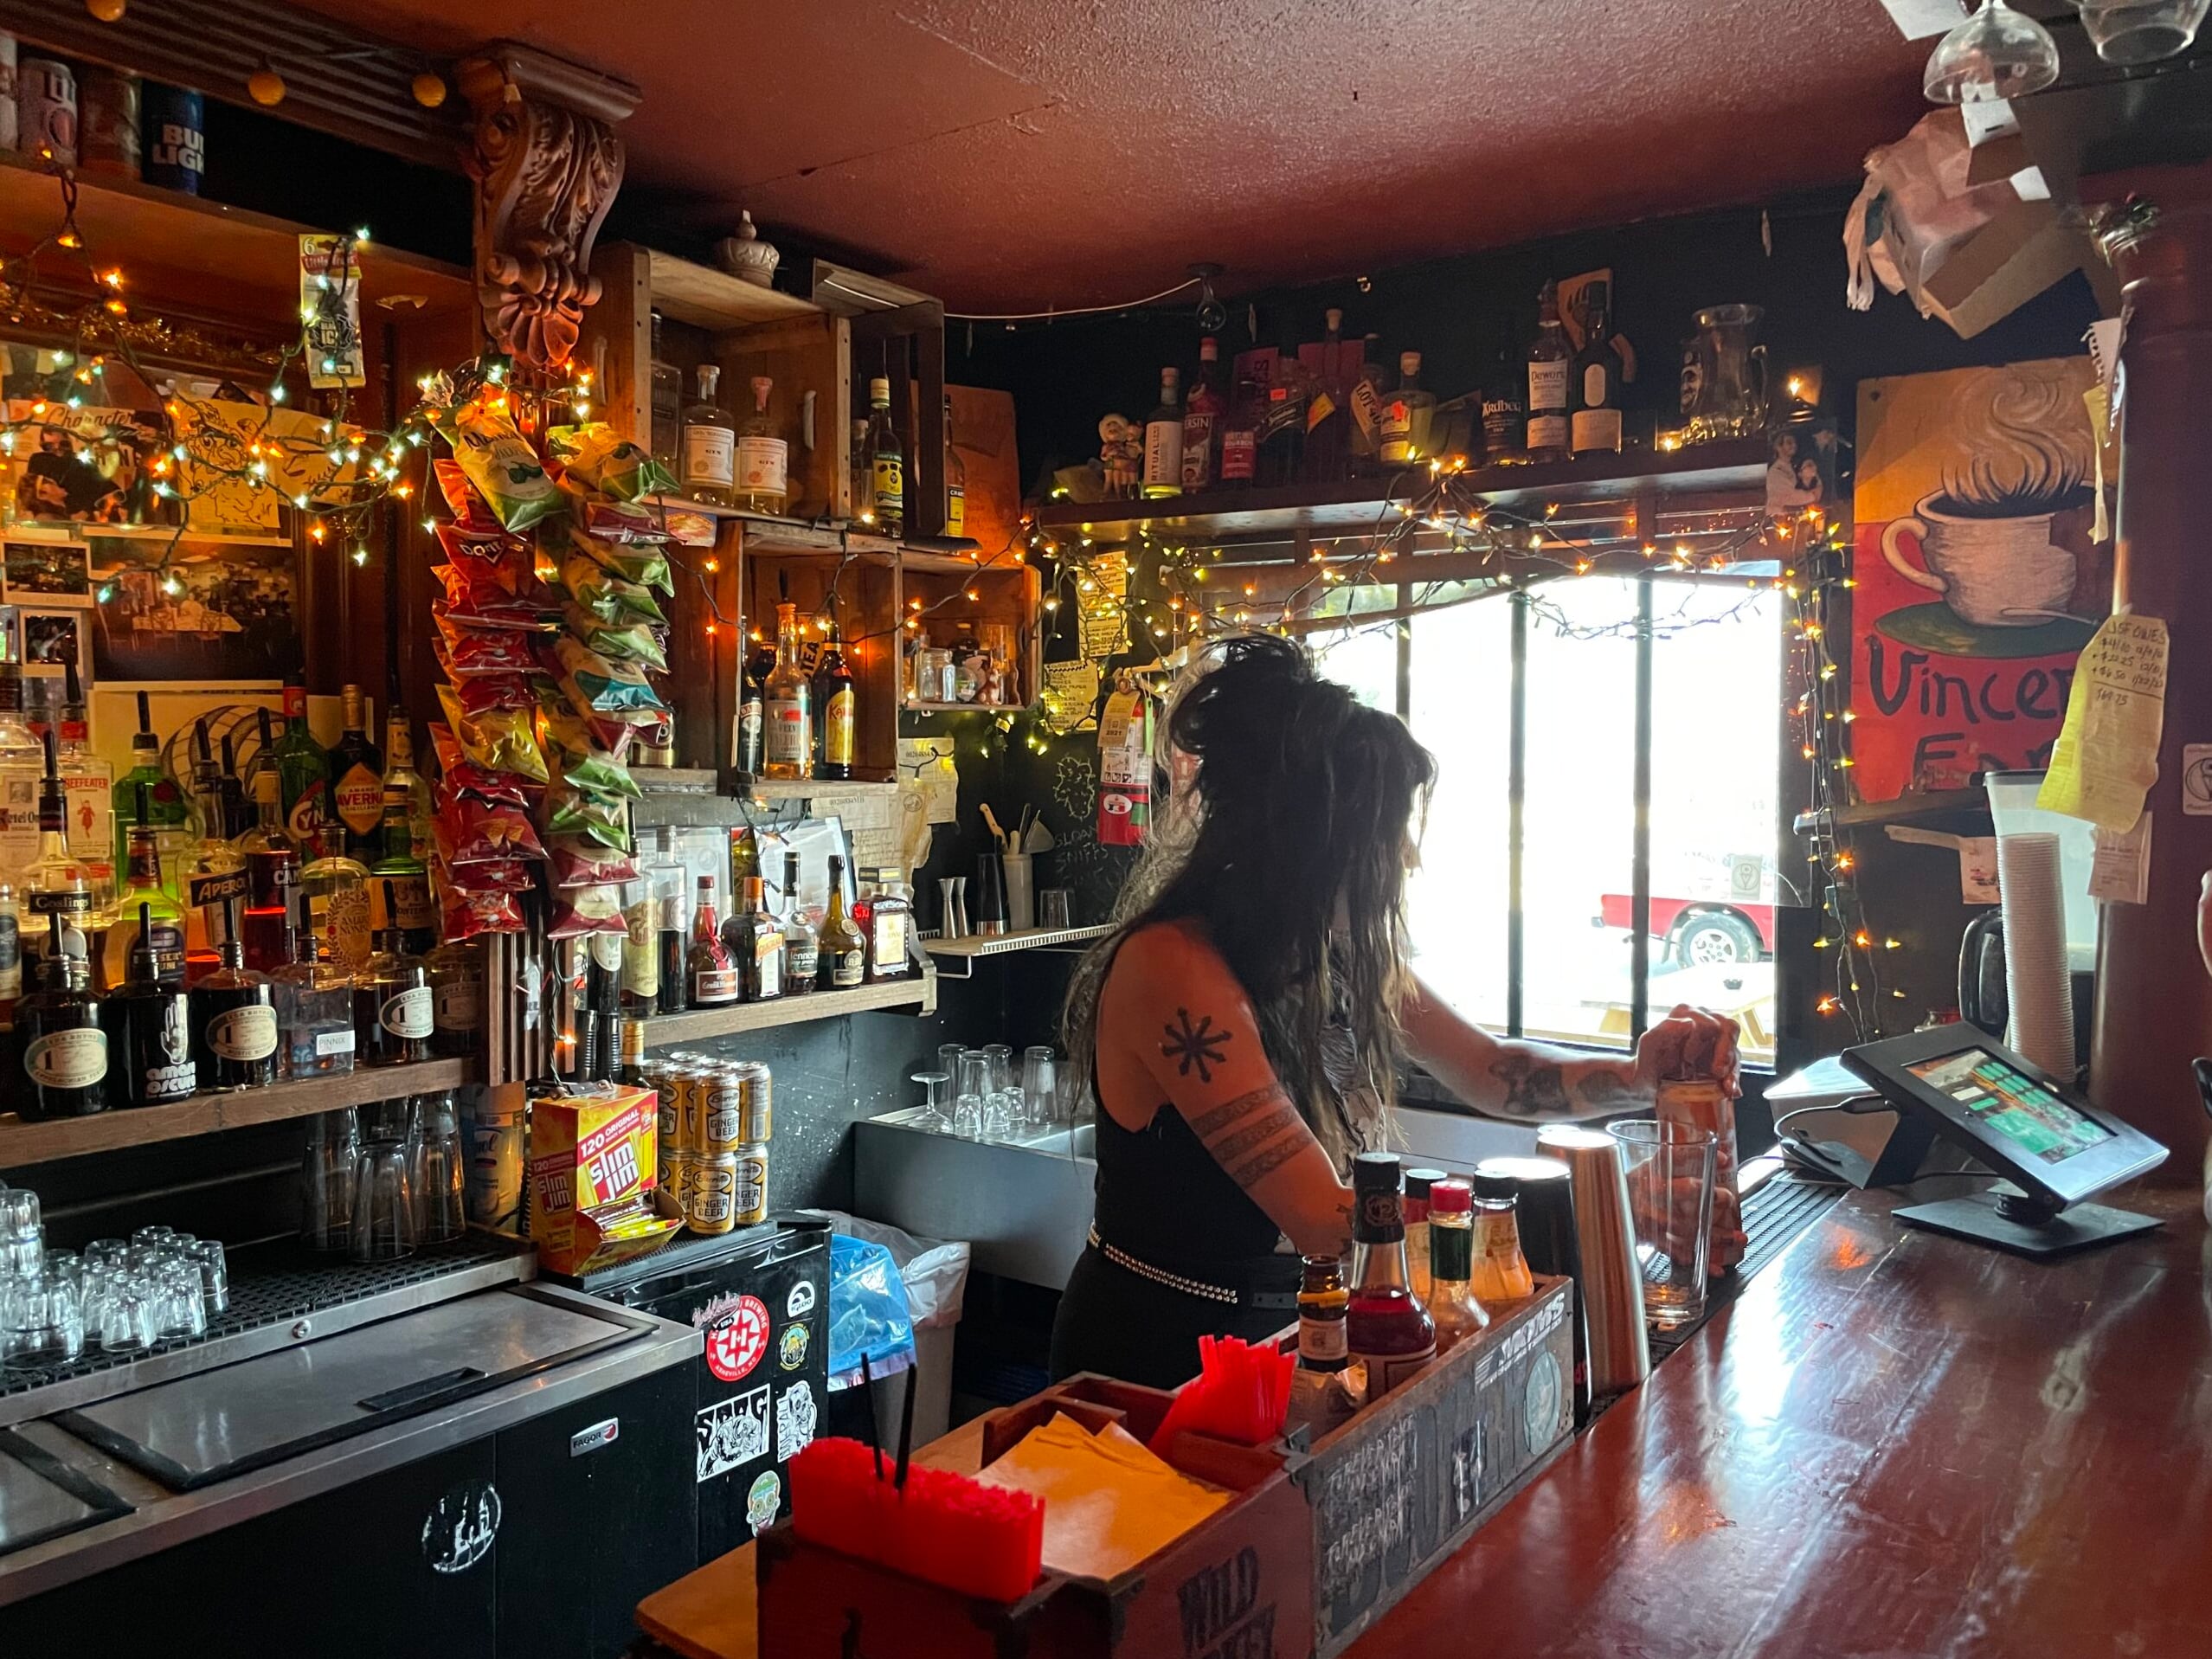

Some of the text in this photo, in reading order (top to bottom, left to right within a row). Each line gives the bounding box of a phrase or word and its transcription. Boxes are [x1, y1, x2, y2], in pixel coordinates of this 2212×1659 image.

[163, 124, 204, 154] BU
[321, 330, 338, 345] IC
[1356, 384, 1376, 408] LOT
[66, 778, 108, 790] BEEFEATER
[198, 878, 248, 902] APERO
[35, 897, 90, 909] Goslings
[580, 1135, 606, 1158] 120
[605, 1109, 640, 1136] ORIGINAL
[694, 1197, 728, 1207] GINGER
[698, 1206, 724, 1217] BEER
[745, 1298, 768, 1328] BREWING
[573, 1431, 602, 1449] FAGOR
